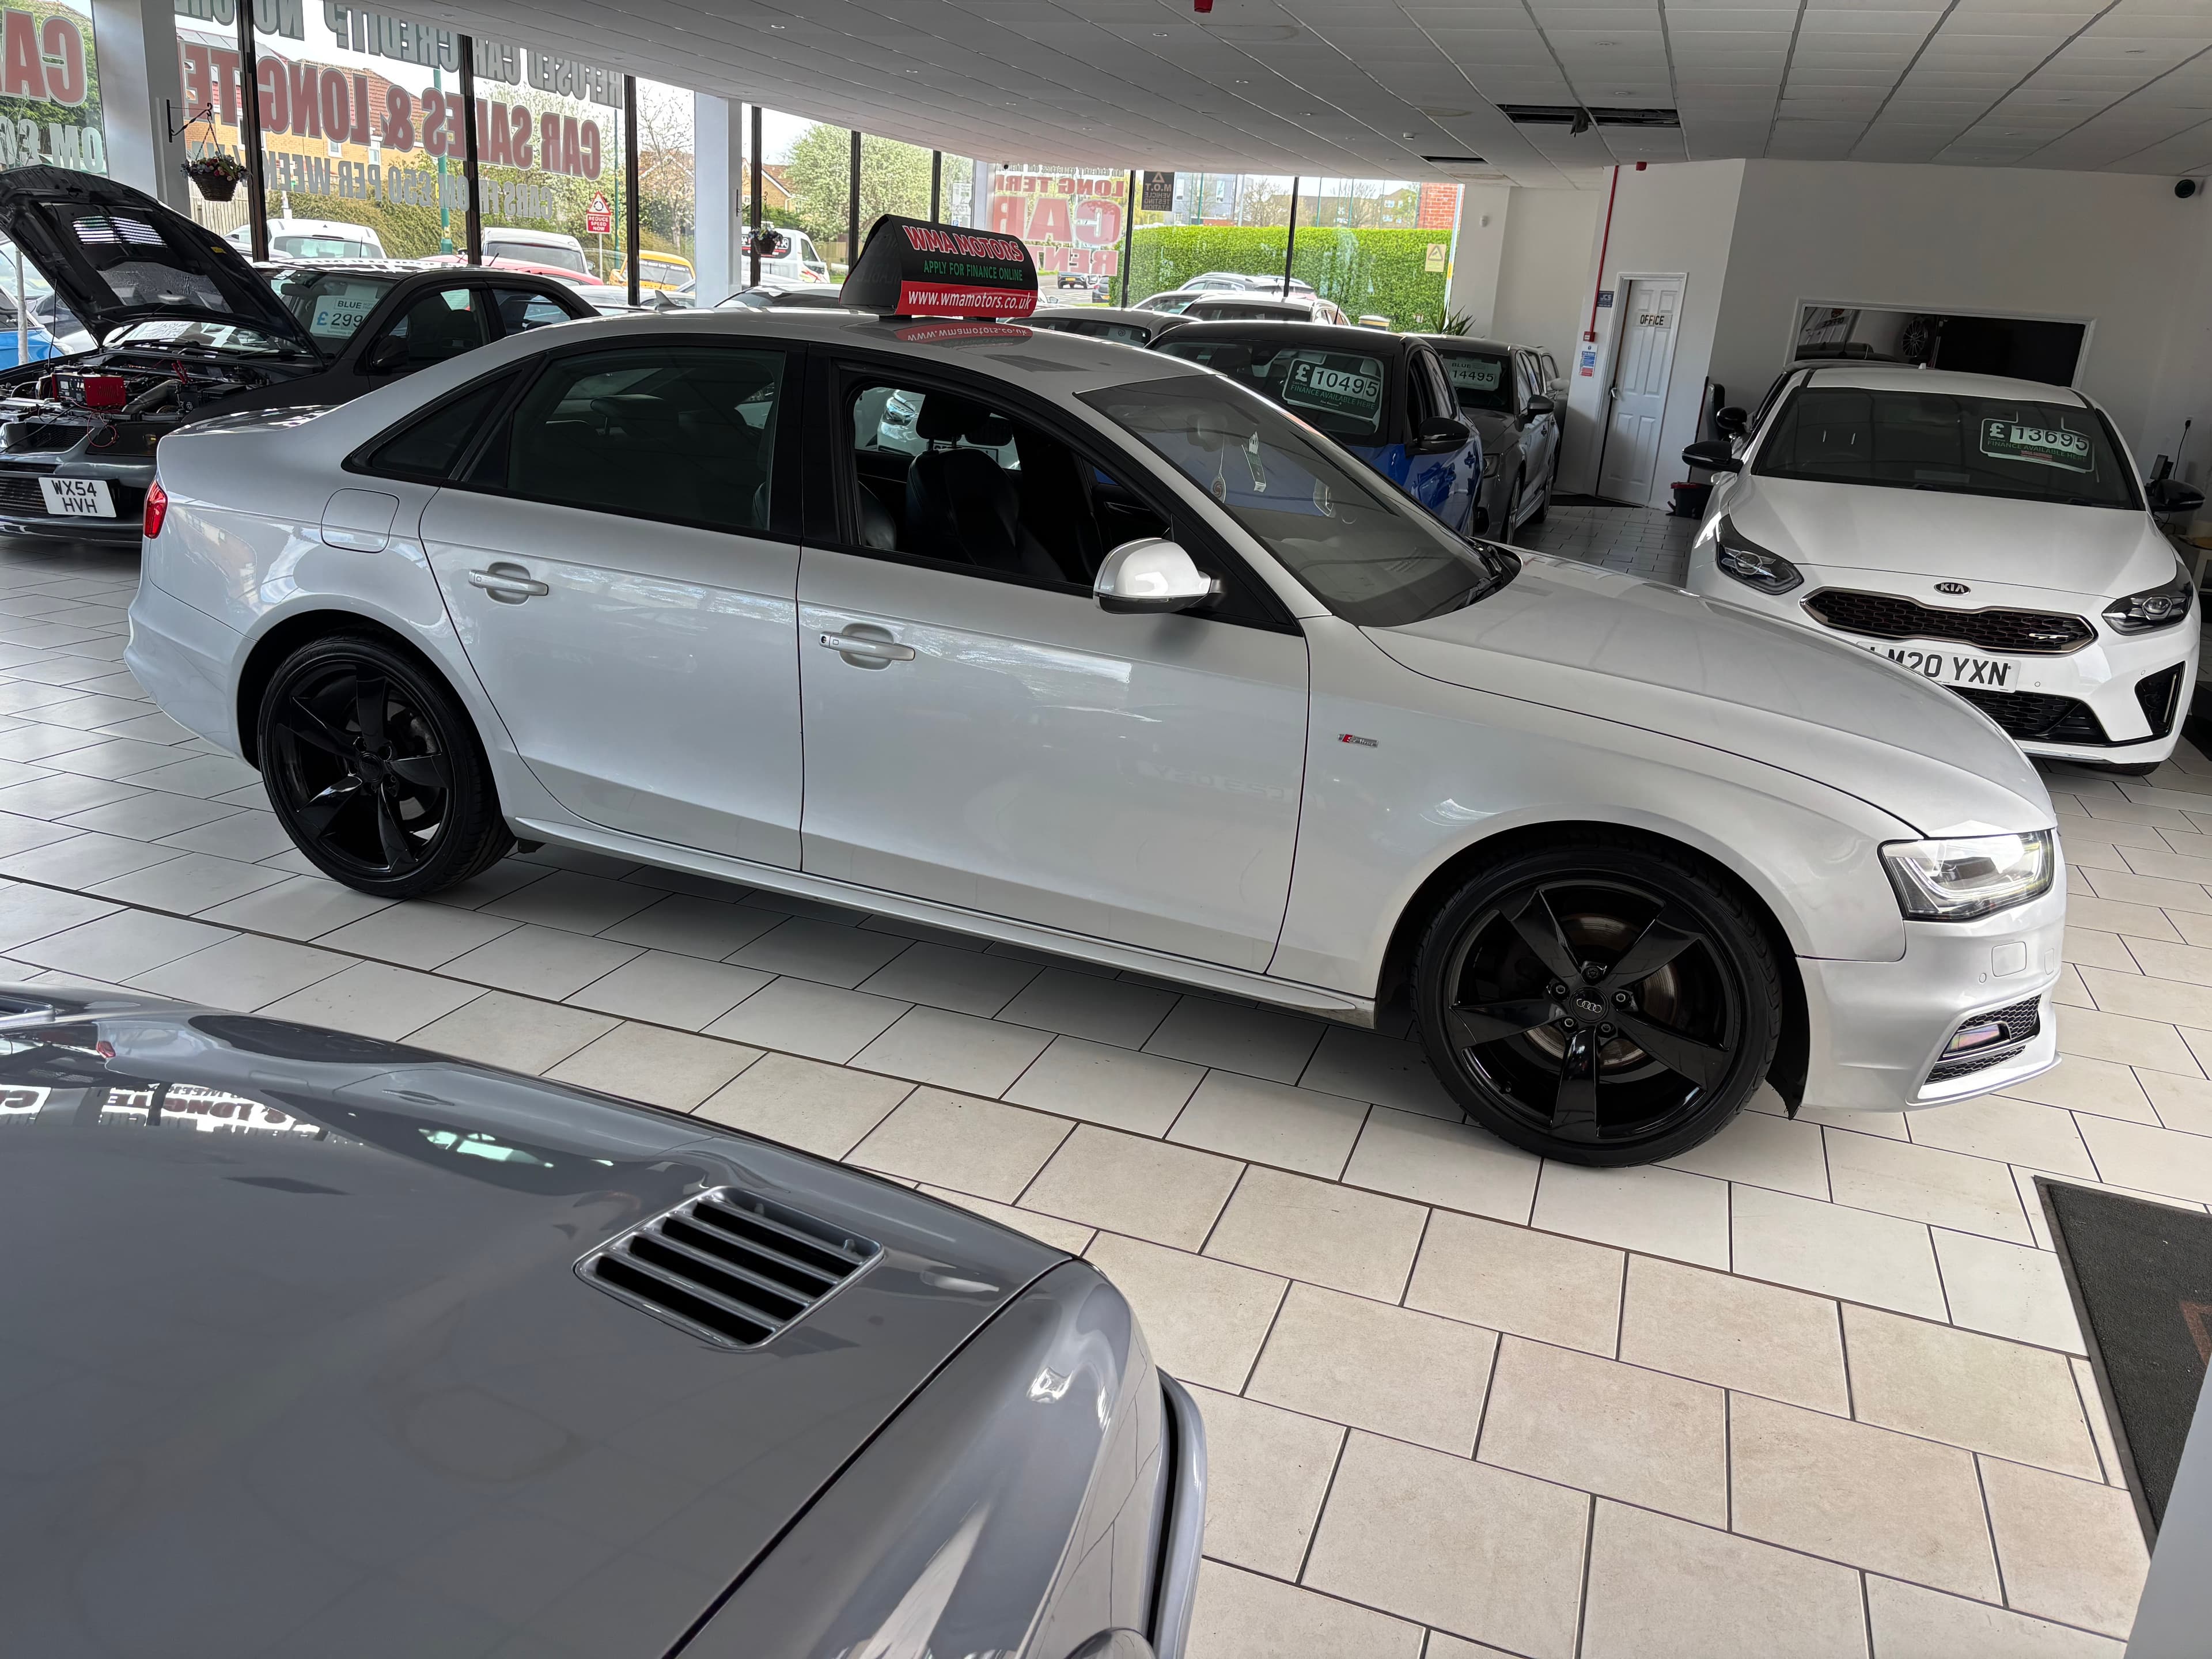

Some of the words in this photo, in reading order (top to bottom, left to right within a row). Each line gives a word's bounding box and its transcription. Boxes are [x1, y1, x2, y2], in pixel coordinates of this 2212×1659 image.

[902, 224, 958, 255] WMA
[953, 233, 1024, 262] MOTORS
[923, 260, 947, 275] APPLY
[949, 262, 965, 276] FOR
[966, 264, 997, 280] FINANCE
[998, 267, 1023, 282] ONLINE
[338, 301, 362, 309] BLUE
[908, 290, 1032, 310] www.wmamotors.co.uk
[317, 311, 328, 325] £
[1640, 313, 1664, 326] OFFICE
[1316, 369, 1379, 397] 10495
[1452, 370, 1494, 382] 14495
[1290, 384, 1319, 396] FINANCE
[1320, 391, 1355, 406] AVAILABLE
[1357, 400, 1376, 410] HERE
[1990, 423, 2005, 438] £
[2016, 427, 2088, 451] 13695
[1987, 440, 2022, 449] FINANCE
[2023, 445, 2065, 457] AVAILABLE
[2067, 453, 2086, 462] HERE
[52, 480, 97, 497] WX54
[62, 497, 98, 513] HVH
[1941, 582, 1965, 594] KIA
[1953, 657, 2009, 686] YXN
